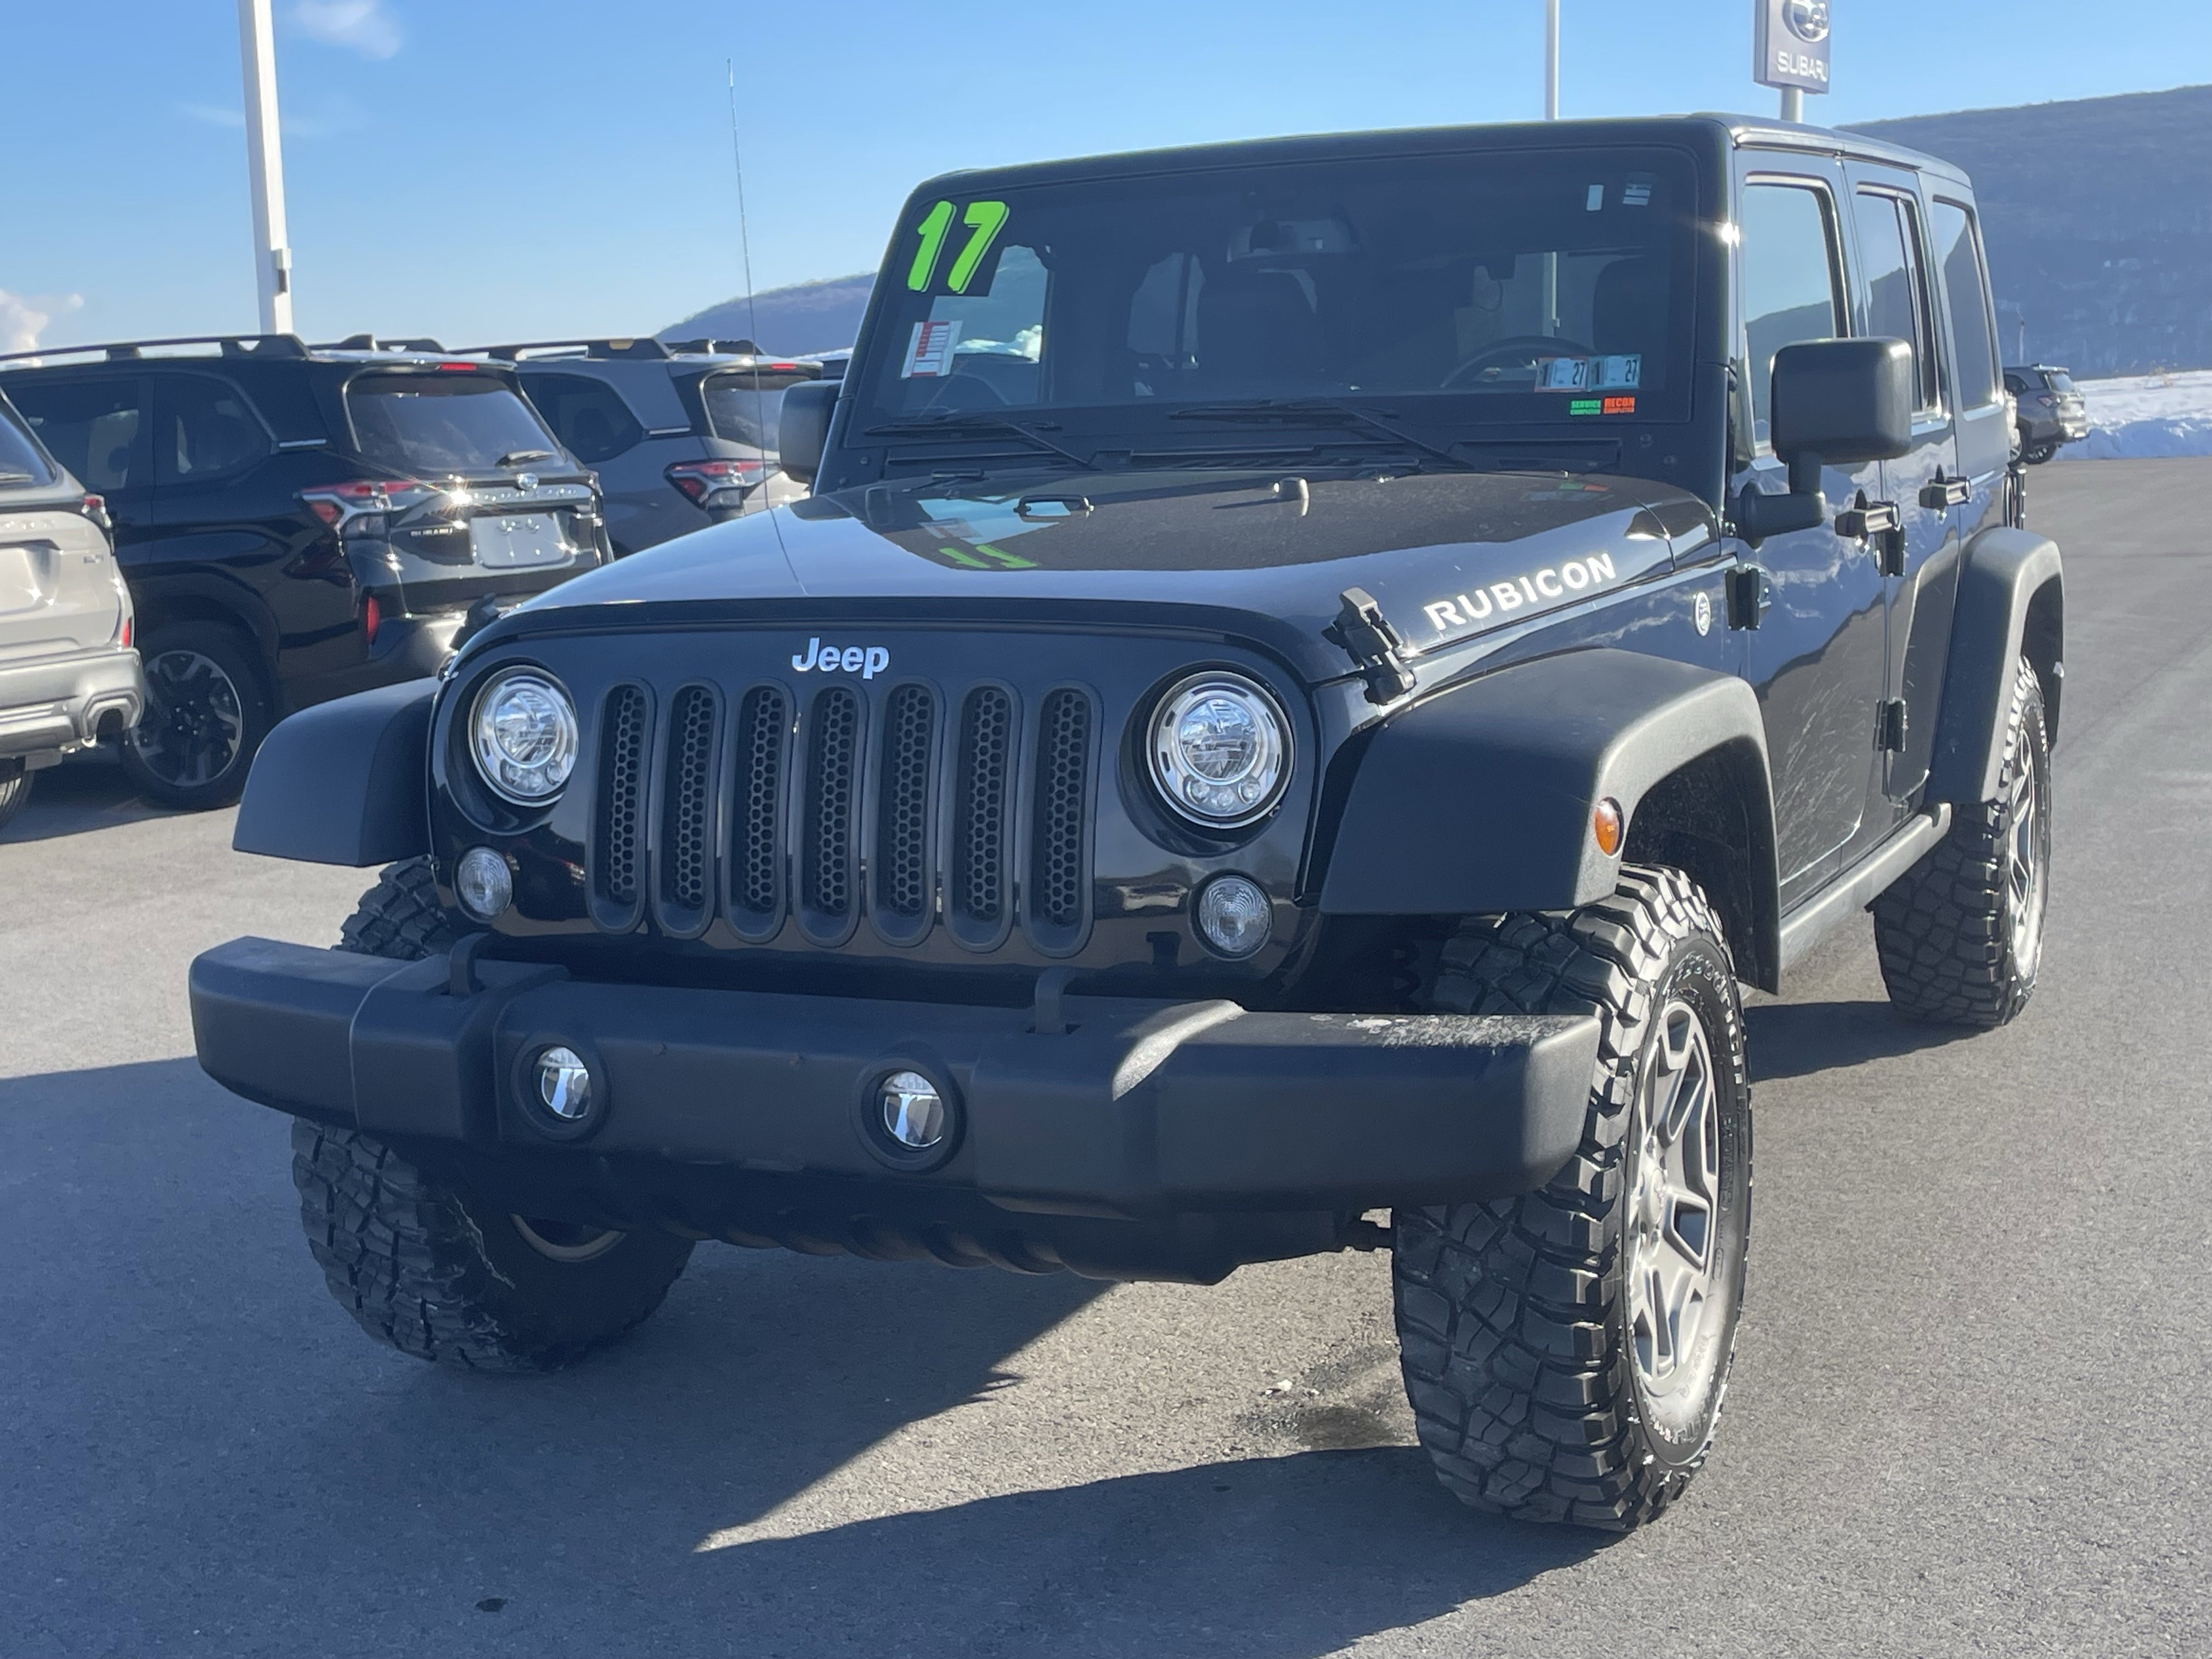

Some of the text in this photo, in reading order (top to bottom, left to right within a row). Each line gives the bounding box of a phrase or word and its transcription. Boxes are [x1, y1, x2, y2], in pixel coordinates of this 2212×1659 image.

[1778, 50, 1828, 82] SUBARU
[907, 200, 1010, 295] 17
[1572, 362, 1585, 385] 27
[1625, 359, 1638, 382] 27
[1424, 552, 1617, 630] RUBICON
[792, 637, 889, 680] Jeep
